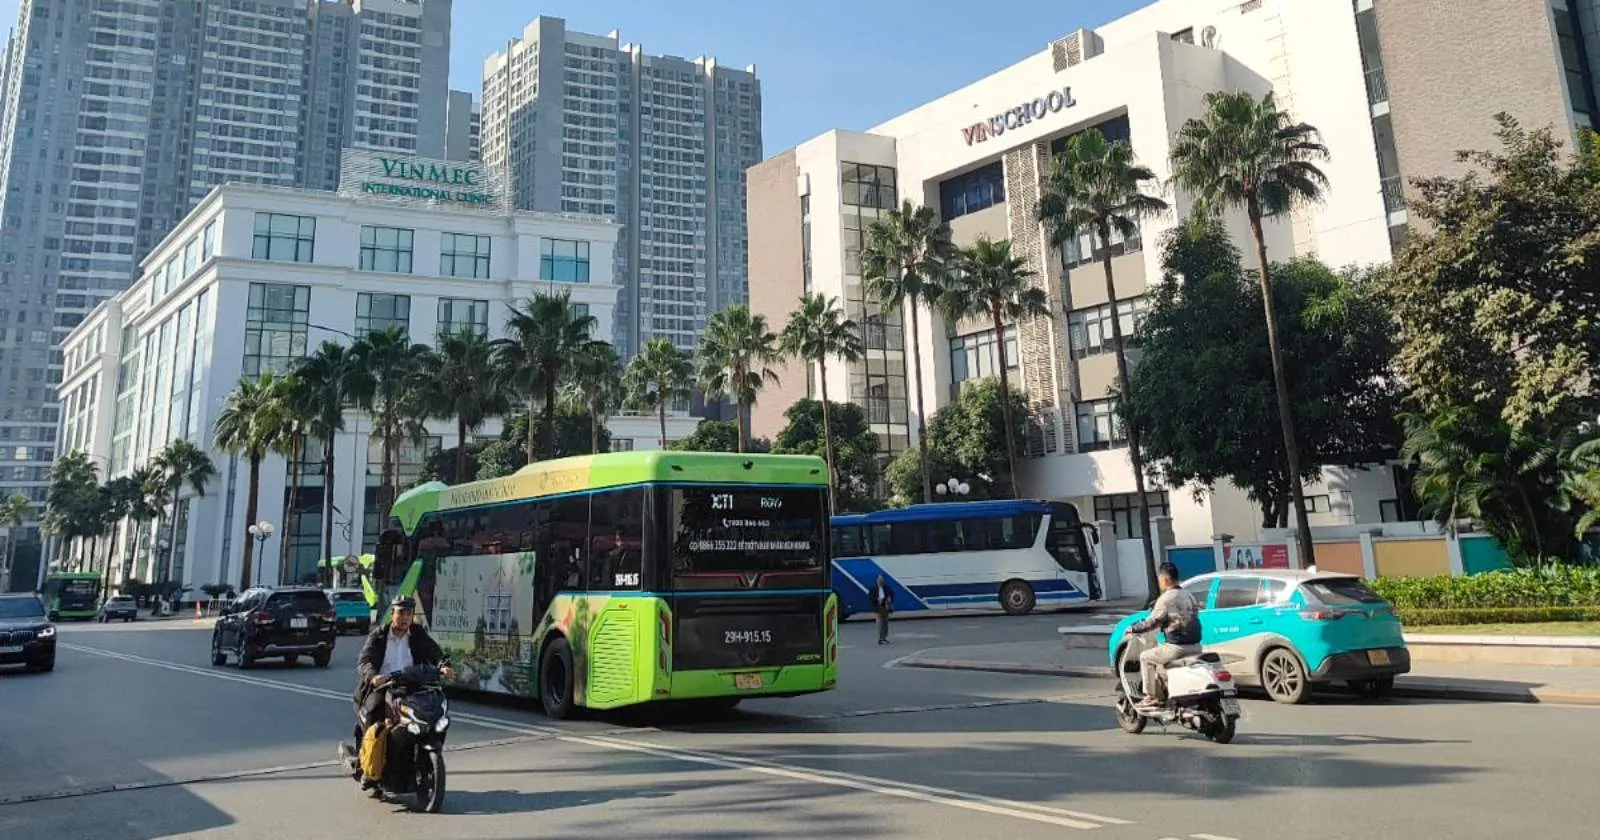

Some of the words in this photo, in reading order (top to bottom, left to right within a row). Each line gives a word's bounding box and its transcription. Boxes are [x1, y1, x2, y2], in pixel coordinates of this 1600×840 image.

[961, 86, 1077, 146] VINSCHOOL
[378, 157, 480, 186] VINMEC
[361, 181, 453, 201] INTERNATIONAL
[455, 192, 494, 205] CLINIC
[724, 630, 772, 644] 29H-915.15
